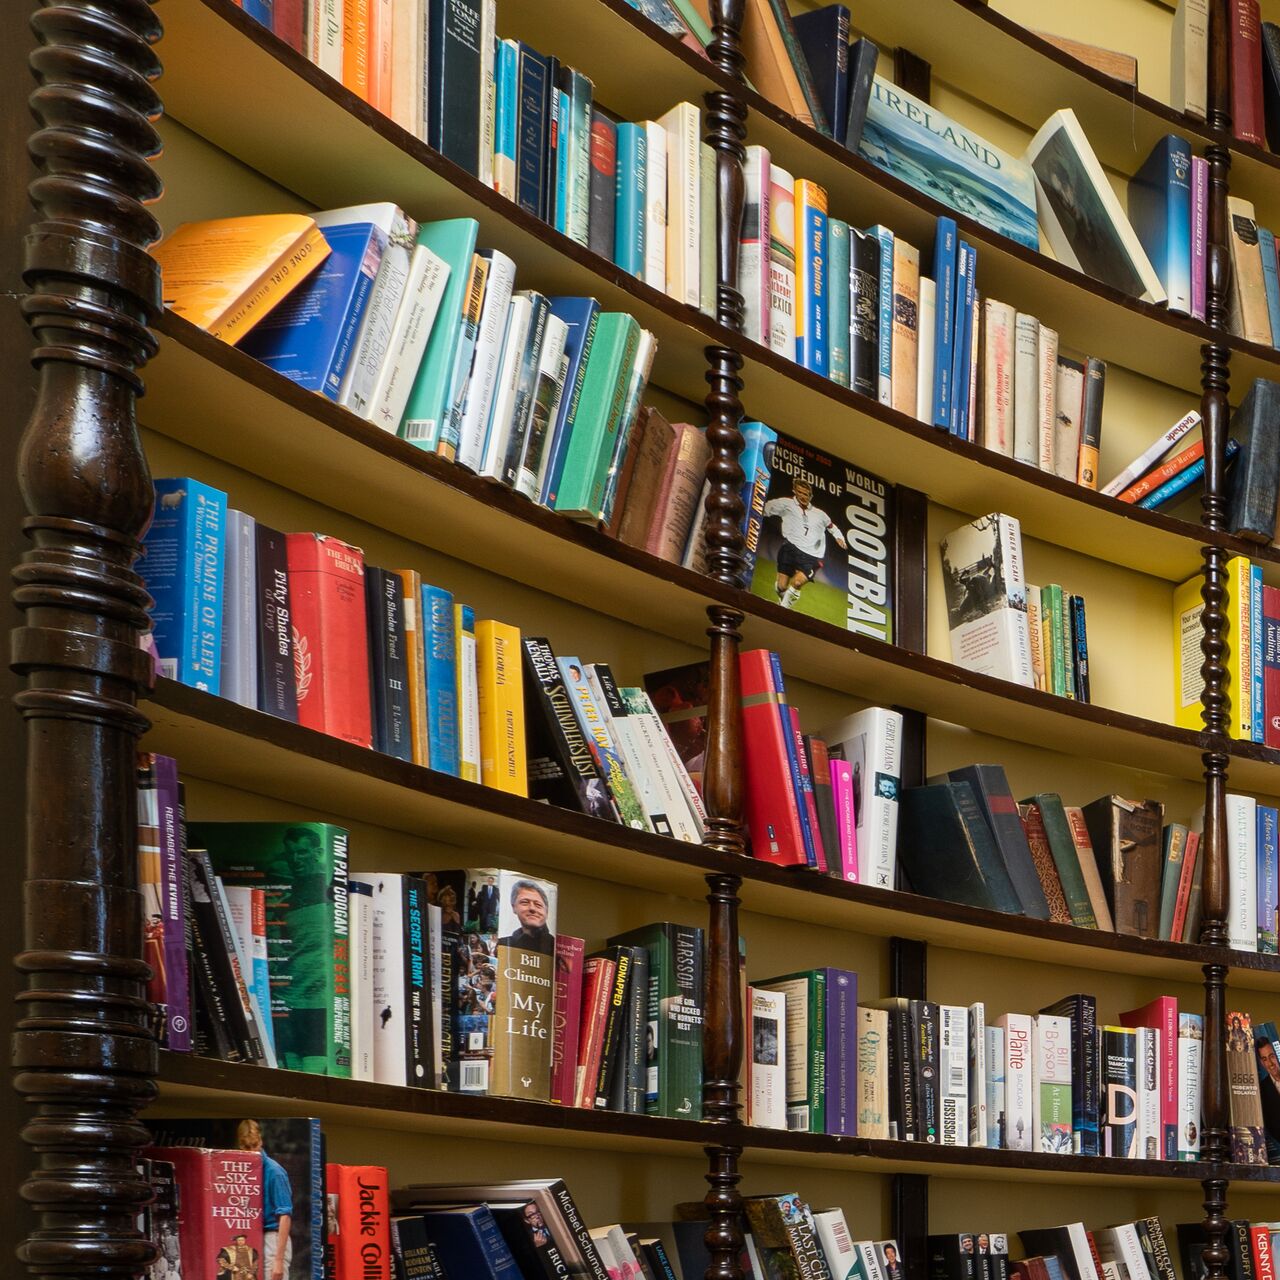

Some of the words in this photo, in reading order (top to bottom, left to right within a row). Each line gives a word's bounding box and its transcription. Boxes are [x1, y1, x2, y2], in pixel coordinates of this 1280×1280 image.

[450, 4, 478, 26] TONE
[871, 82, 1002, 171] IRELAND
[813, 216, 822, 230] In
[291, 242, 312, 269] GONE
[812, 232, 822, 259] Your
[270, 268, 292, 288] GIRL
[813, 258, 822, 297] Opinion
[244, 284, 271, 312] GILLIAN
[226, 304, 252, 330] FLYNN
[845, 467, 885, 497] WORLD
[206, 500, 219, 531] THE
[204, 537, 218, 602] PROMISE
[275, 569, 286, 599] Fifty
[204, 606, 216, 627] OF
[276, 601, 289, 656] Shades
[1029, 605, 1038, 625] DAN
[203, 631, 215, 676] SLEEP
[1030, 626, 1041, 666] BROWN
[1266, 623, 1275, 667] Auditing
[525, 640, 551, 683] KENEALLY
[538, 644, 560, 680] THOMAS
[576, 687, 596, 725] PETER
[591, 728, 610, 750] KAY
[795, 730, 804, 746] red
[800, 747, 808, 769] wine
[408, 889, 418, 908] THE
[409, 908, 421, 950] SECRET
[411, 953, 425, 988] ARMY
[520, 954, 540, 969] Bill
[676, 932, 694, 990] LARSSON
[504, 968, 550, 988] Clinton
[613, 956, 628, 1006] KIDNAPPED
[413, 1007, 421, 1021] IRA
[512, 992, 546, 1019] My
[506, 1017, 548, 1040] Life
[1009, 1030, 1027, 1070] Plante
[1045, 1030, 1059, 1079] Bryson
[1057, 1047, 1068, 1067] Bill
[1185, 1043, 1197, 1074] World
[1053, 1087, 1060, 1096] At
[1232, 1073, 1255, 1084] 2666
[1182, 1077, 1197, 1118] History
[220, 1161, 253, 1173] THE
[215, 1184, 261, 1196] WIVES
[228, 1196, 250, 1208] OF
[212, 1207, 262, 1220] HENRY
[357, 1176, 380, 1237] Jackie
[557, 1190, 583, 1233] Michael
[225, 1219, 251, 1229] VIII
[1236, 1224, 1247, 1242] JOE
[798, 1224, 817, 1257] LAST
[1257, 1233, 1271, 1272] KENNY
[547, 1248, 566, 1276] ERIC
[864, 1246, 874, 1266] LOUIS
[1240, 1244, 1251, 1276] DUFFY
